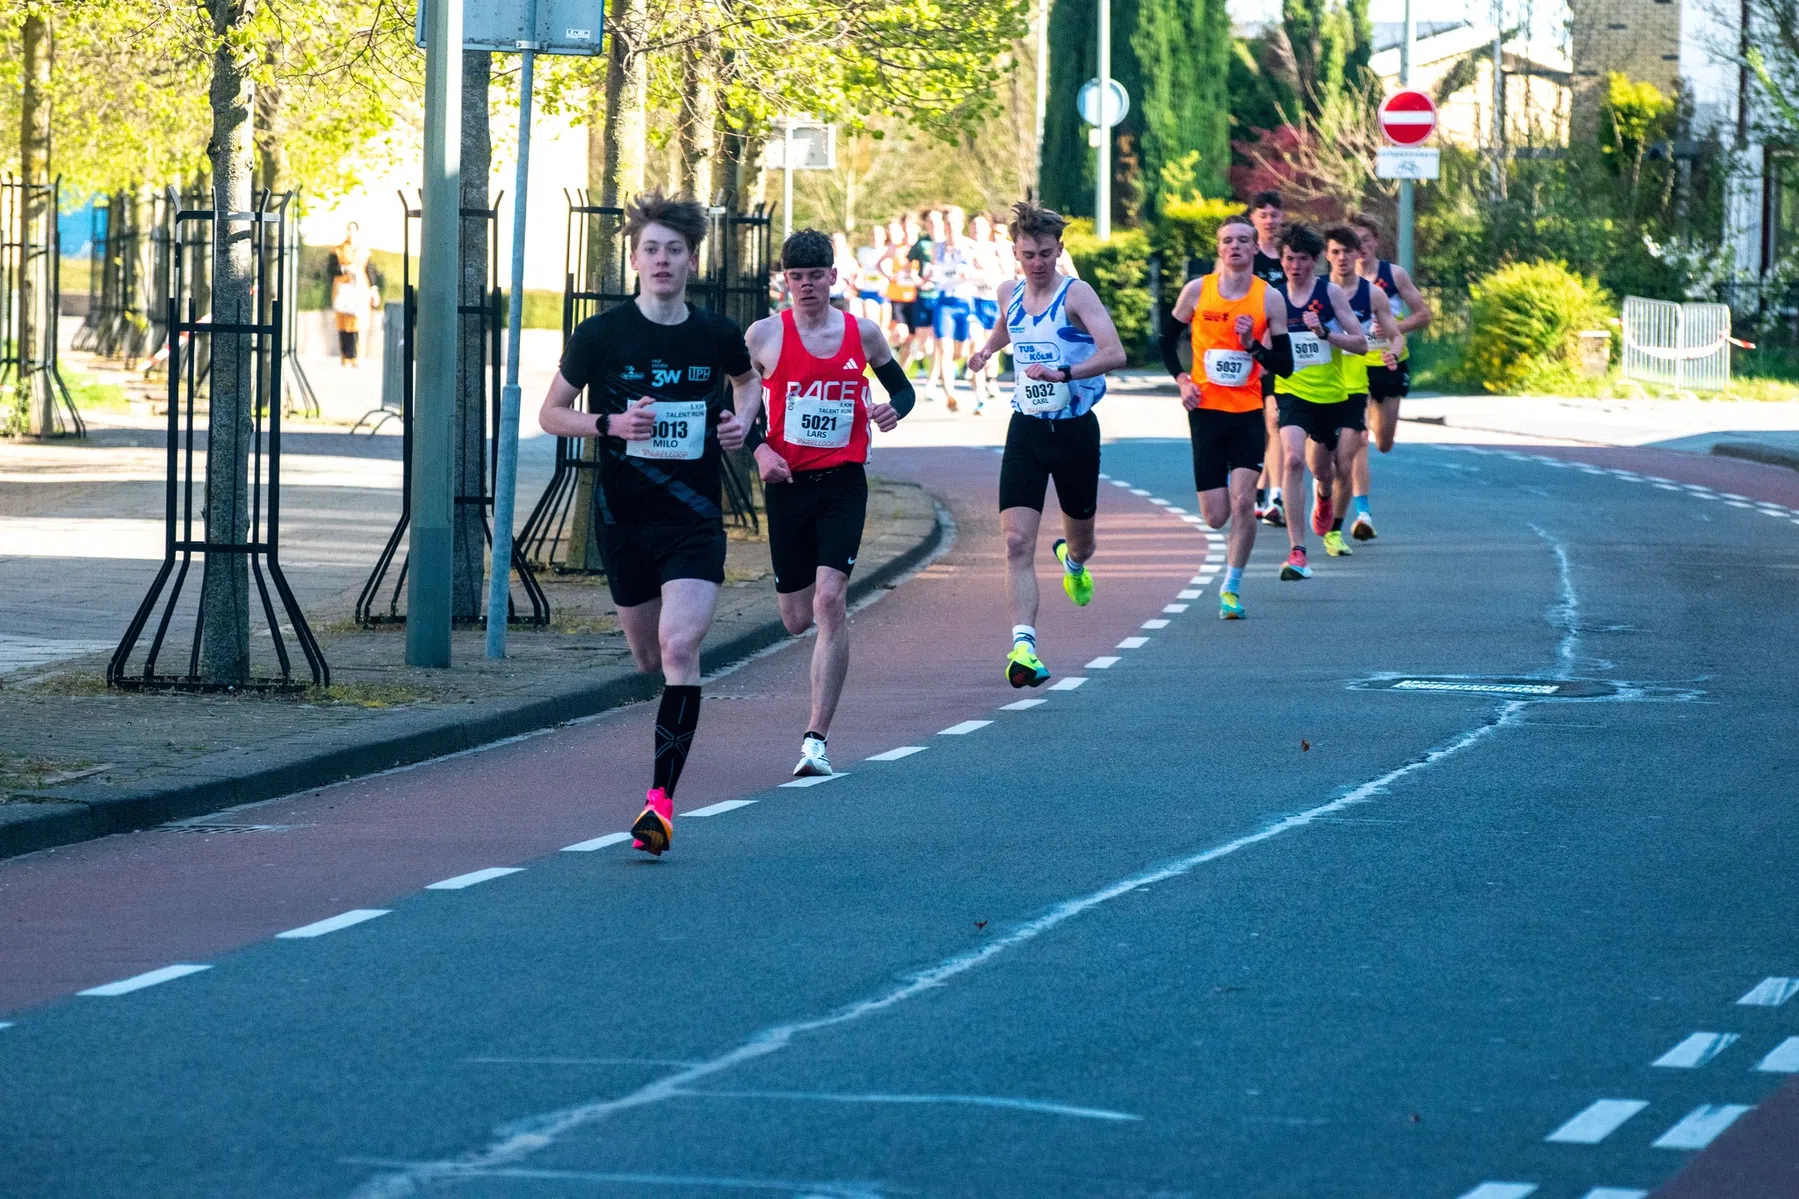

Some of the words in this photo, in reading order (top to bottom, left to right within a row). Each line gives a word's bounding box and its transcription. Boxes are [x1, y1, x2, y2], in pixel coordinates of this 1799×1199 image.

[1018, 345, 1036, 353] TUS
[1295, 342, 1319, 354] 5010
[1029, 352, 1053, 361] KÖLN
[1216, 360, 1242, 374] 5037
[651, 369, 682, 387] 3W
[787, 380, 859, 401] RACE
[1025, 383, 1055, 399] 5032
[801, 413, 837, 431] 5021
[807, 430, 827, 438] LARS
[653, 440, 678, 448] MILO
